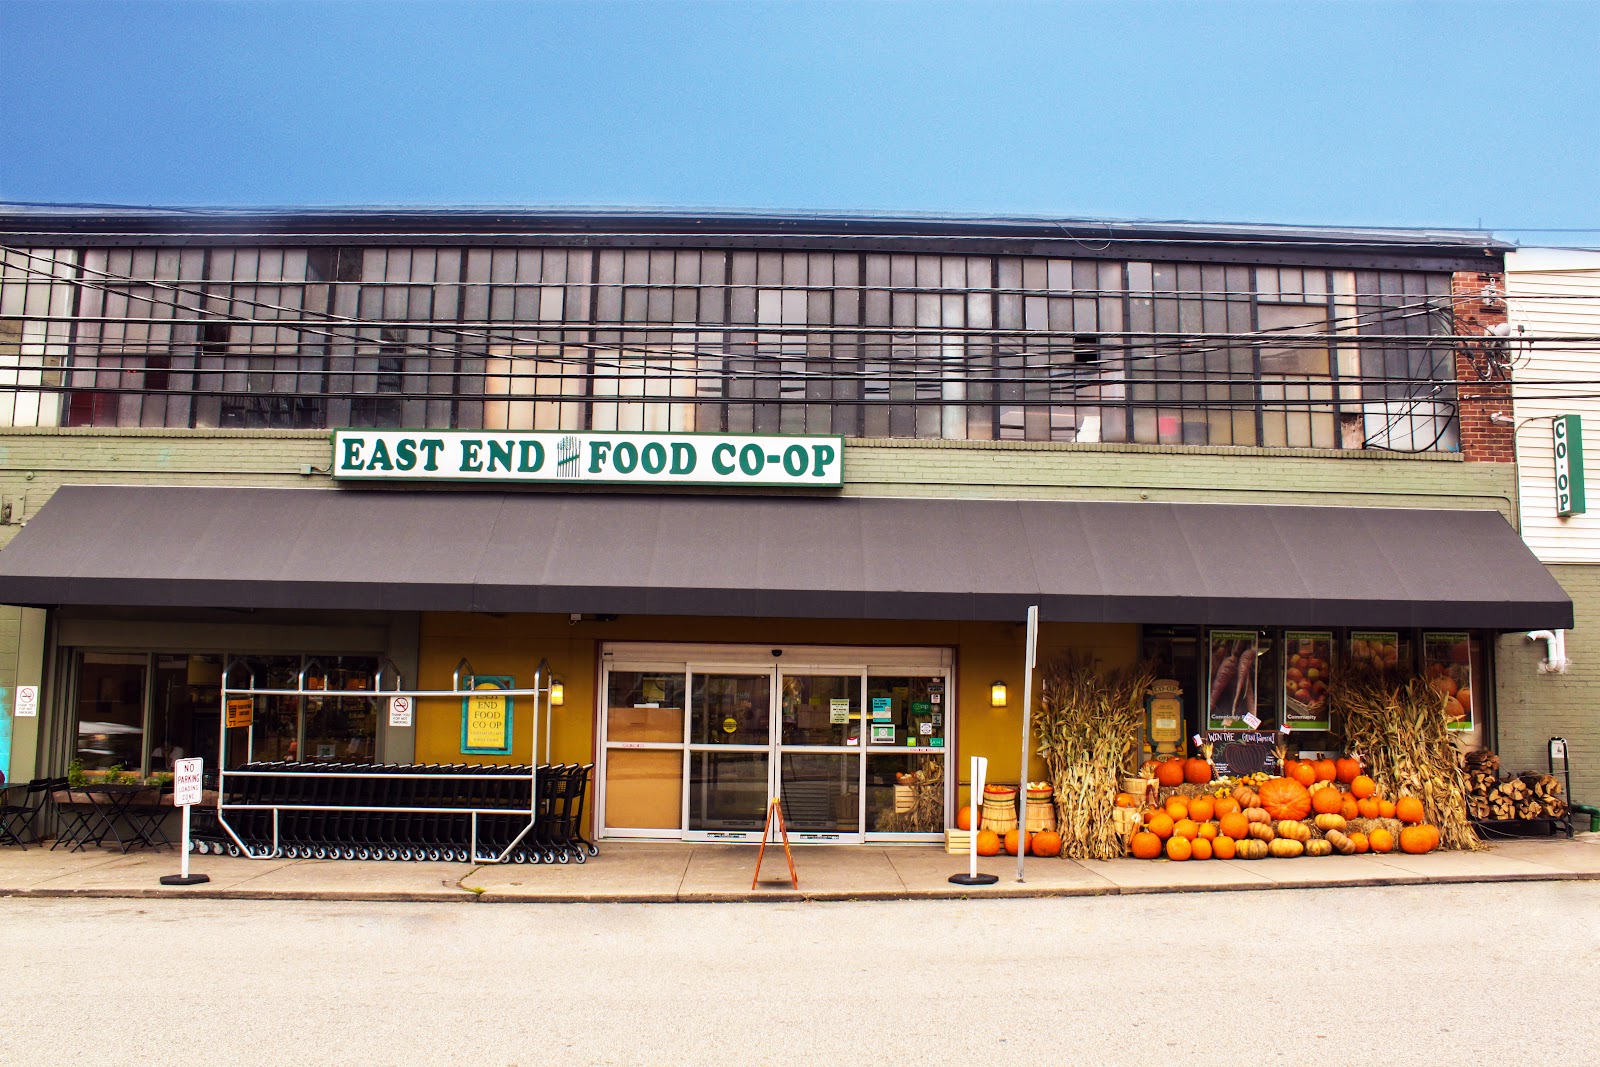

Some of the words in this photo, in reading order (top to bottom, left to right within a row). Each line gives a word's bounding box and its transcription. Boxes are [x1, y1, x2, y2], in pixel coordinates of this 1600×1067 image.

[341, 438, 445, 471] EAST
[459, 440, 545, 472] END
[588, 441, 697, 475] FOOD
[712, 443, 835, 477] CO-OP
[478, 701, 498, 709] END
[474, 711, 501, 719] FOOD
[1208, 732, 1223, 742] WIN
[1222, 732, 1235, 742] THE
[184, 763, 195, 772] NO
[177, 773, 200, 784] PARKING
